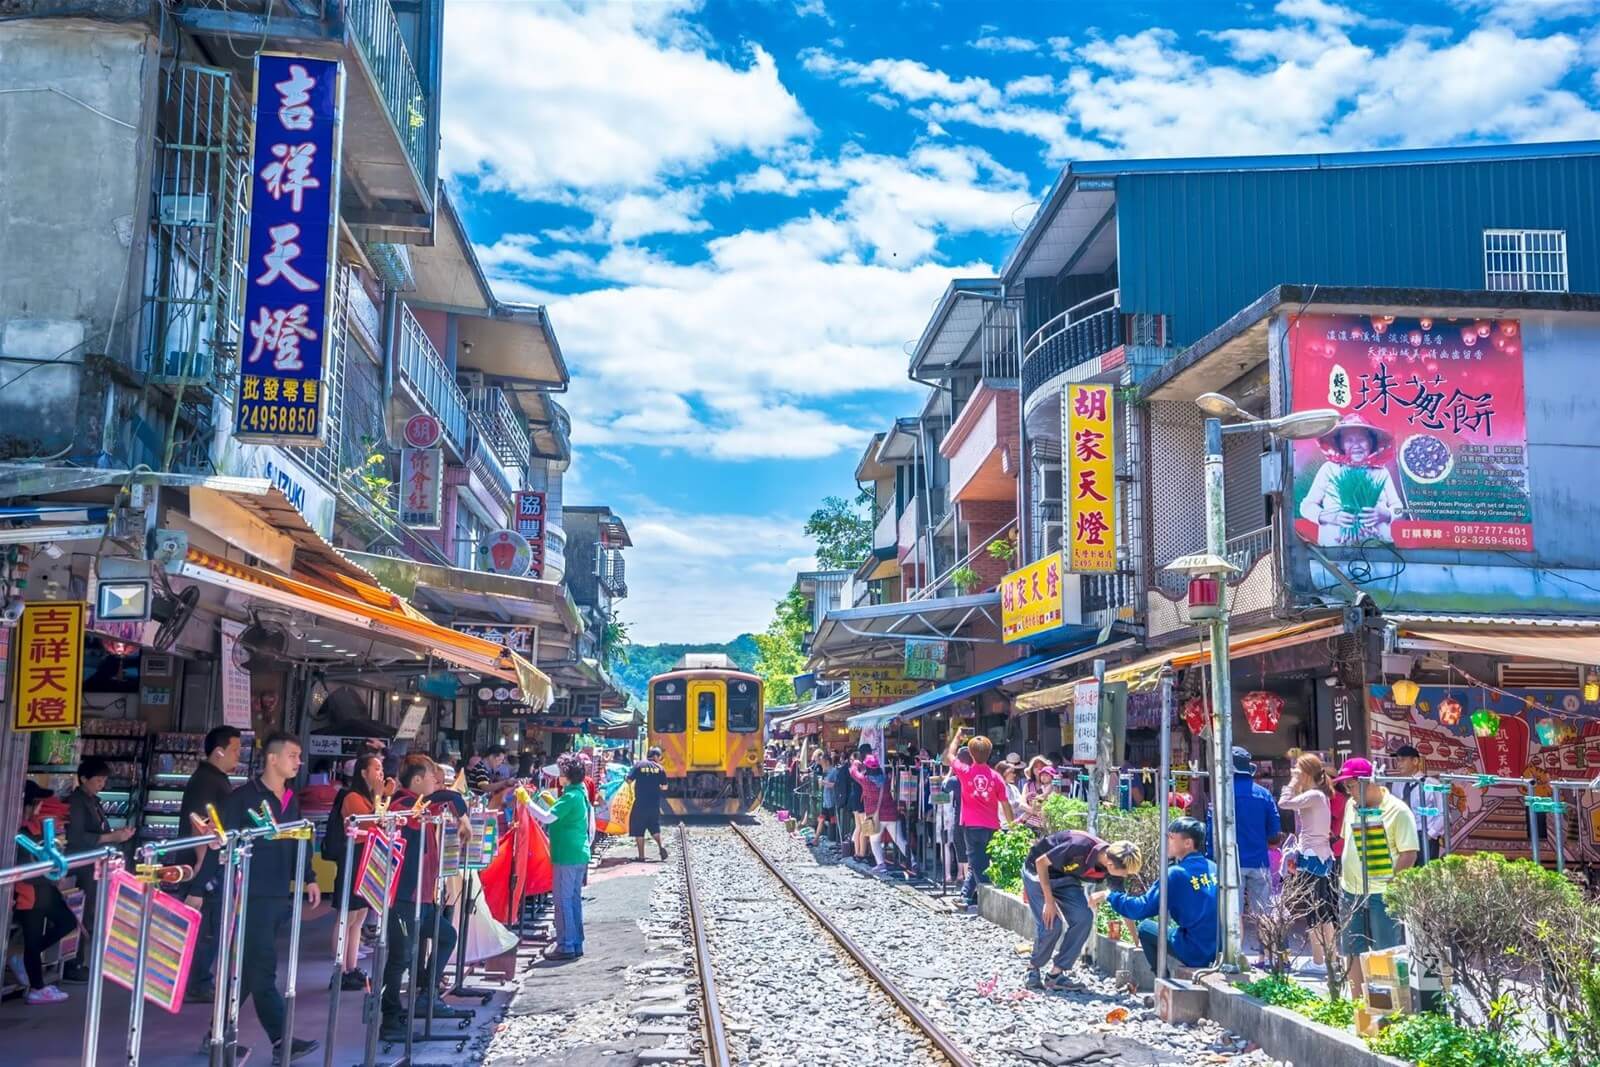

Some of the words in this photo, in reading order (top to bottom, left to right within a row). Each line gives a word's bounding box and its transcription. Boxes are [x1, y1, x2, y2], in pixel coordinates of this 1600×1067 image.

[249, 64, 320, 370] 吉祥天燈
[242, 376, 318, 404] 批發零售
[241, 405, 316, 433] 24958850
[1074, 387, 1109, 545] 胡家天燈
[1476, 502, 1487, 511] gift
[1479, 509, 1487, 517] by
[1004, 562, 1059, 612] 胡家天燈
[27, 609, 73, 723] 吉祥天燈
